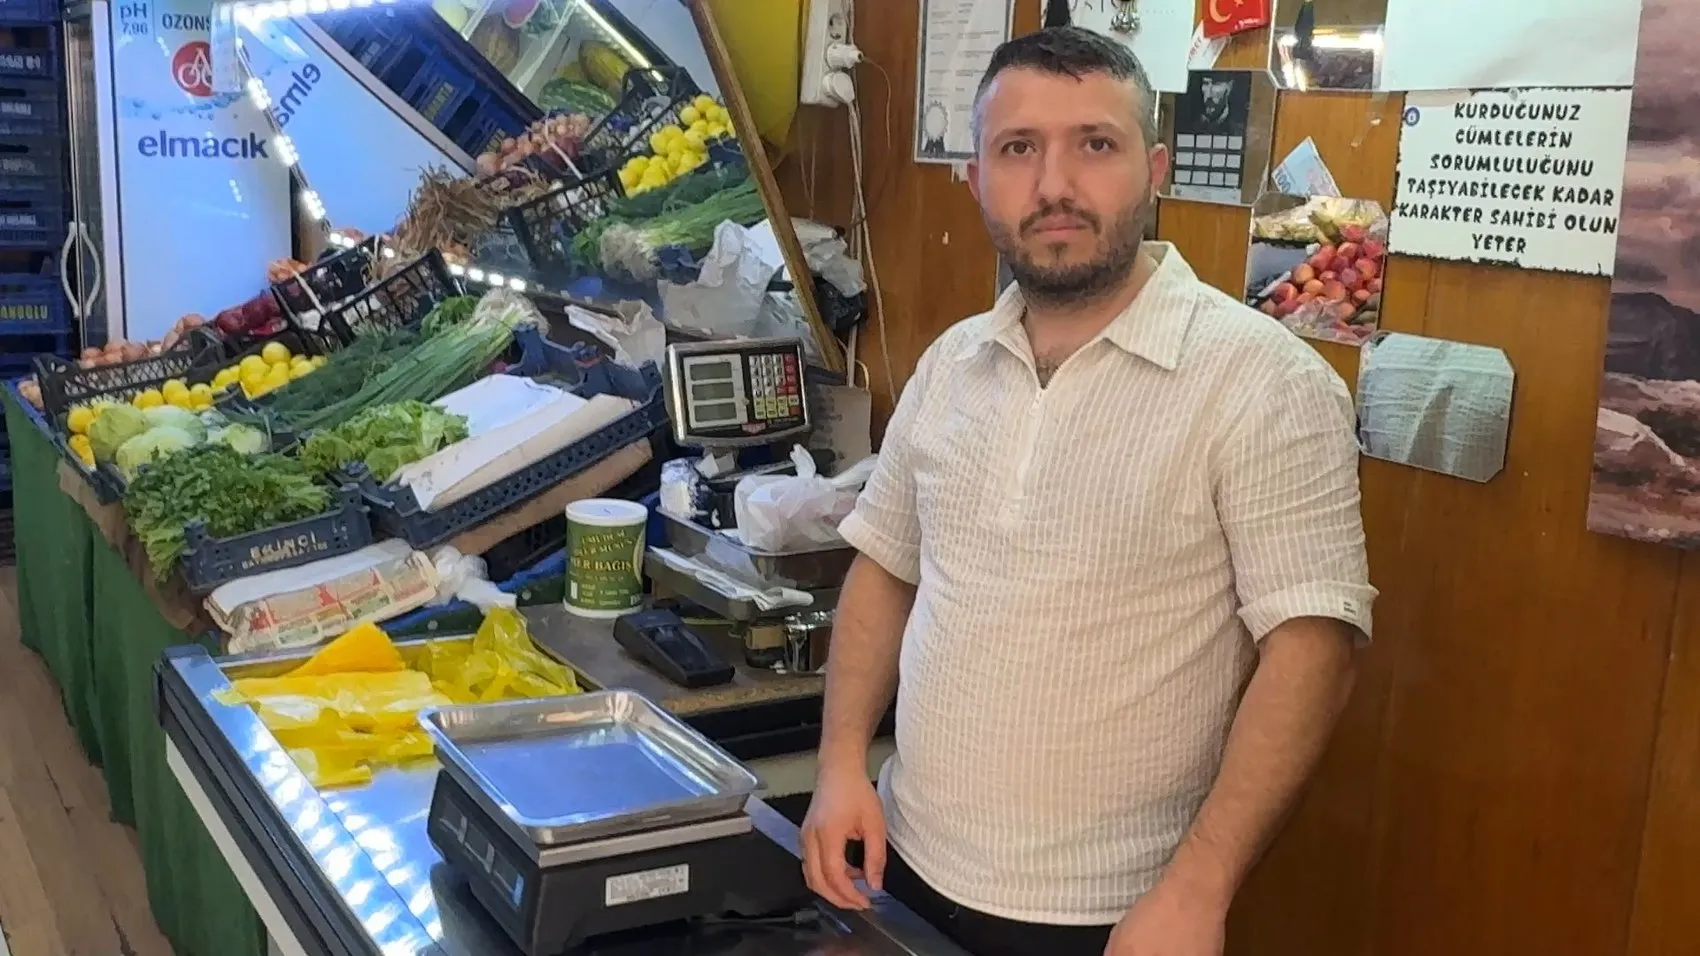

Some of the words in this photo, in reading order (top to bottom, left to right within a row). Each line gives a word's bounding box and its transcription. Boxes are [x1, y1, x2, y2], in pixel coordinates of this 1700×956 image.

[120, 3, 148, 20] pH
[1454, 101, 1582, 121] KURDUĞUNUZ
[137, 131, 269, 159] elmacık
[1455, 126, 1572, 148] CÜMLELERİN
[1430, 154, 1594, 177] SORUMLULUĞUNU
[1407, 178, 1546, 201] TAŞIYABİLECEK
[1552, 186, 1614, 206] KADAR
[1399, 203, 1483, 224] KARAKTER
[1490, 207, 1556, 230] SAHİBİ
[1564, 215, 1617, 234] OLUN
[1472, 233, 1526, 254] YETER
